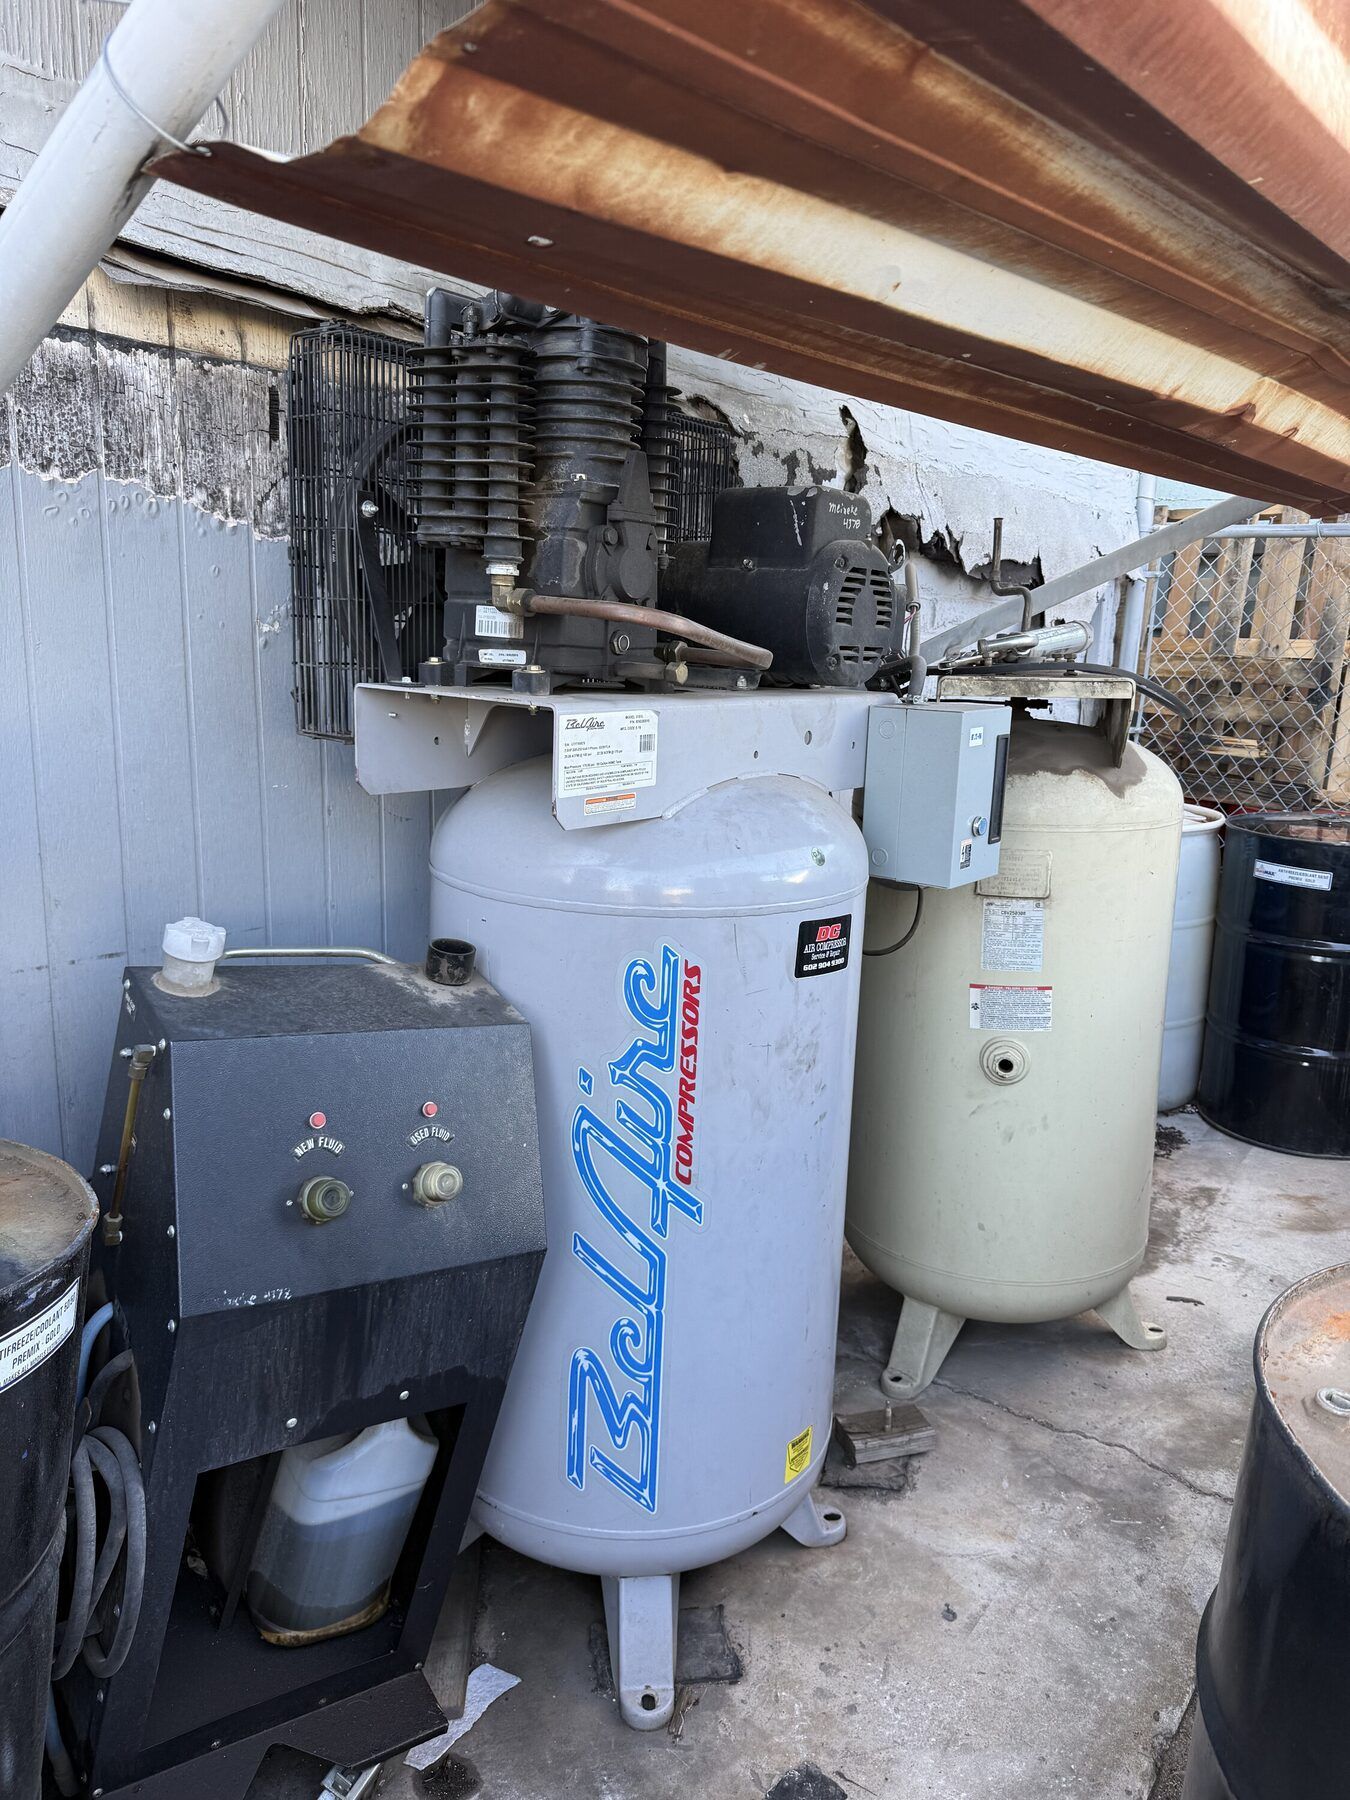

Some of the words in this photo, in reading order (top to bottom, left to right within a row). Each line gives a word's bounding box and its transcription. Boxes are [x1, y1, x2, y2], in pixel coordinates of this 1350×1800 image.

[816, 923, 842, 942] DC
[803, 943, 815, 953] AIR
[816, 937, 847, 951] COMPRESSOR
[811, 952, 826, 960] Service
[803, 963, 818, 971] 602
[818, 961, 831, 969] 904
[675, 958, 702, 1186] COMPRESSORS
[410, 1127, 430, 1145] USED
[431, 1126, 450, 1142] FLUID
[294, 1137, 315, 1157] NEW
[318, 1136, 343, 1154] FLUID
[12, 1341, 40, 1369] PREMIX
[45, 1324, 61, 1345] GOLD
